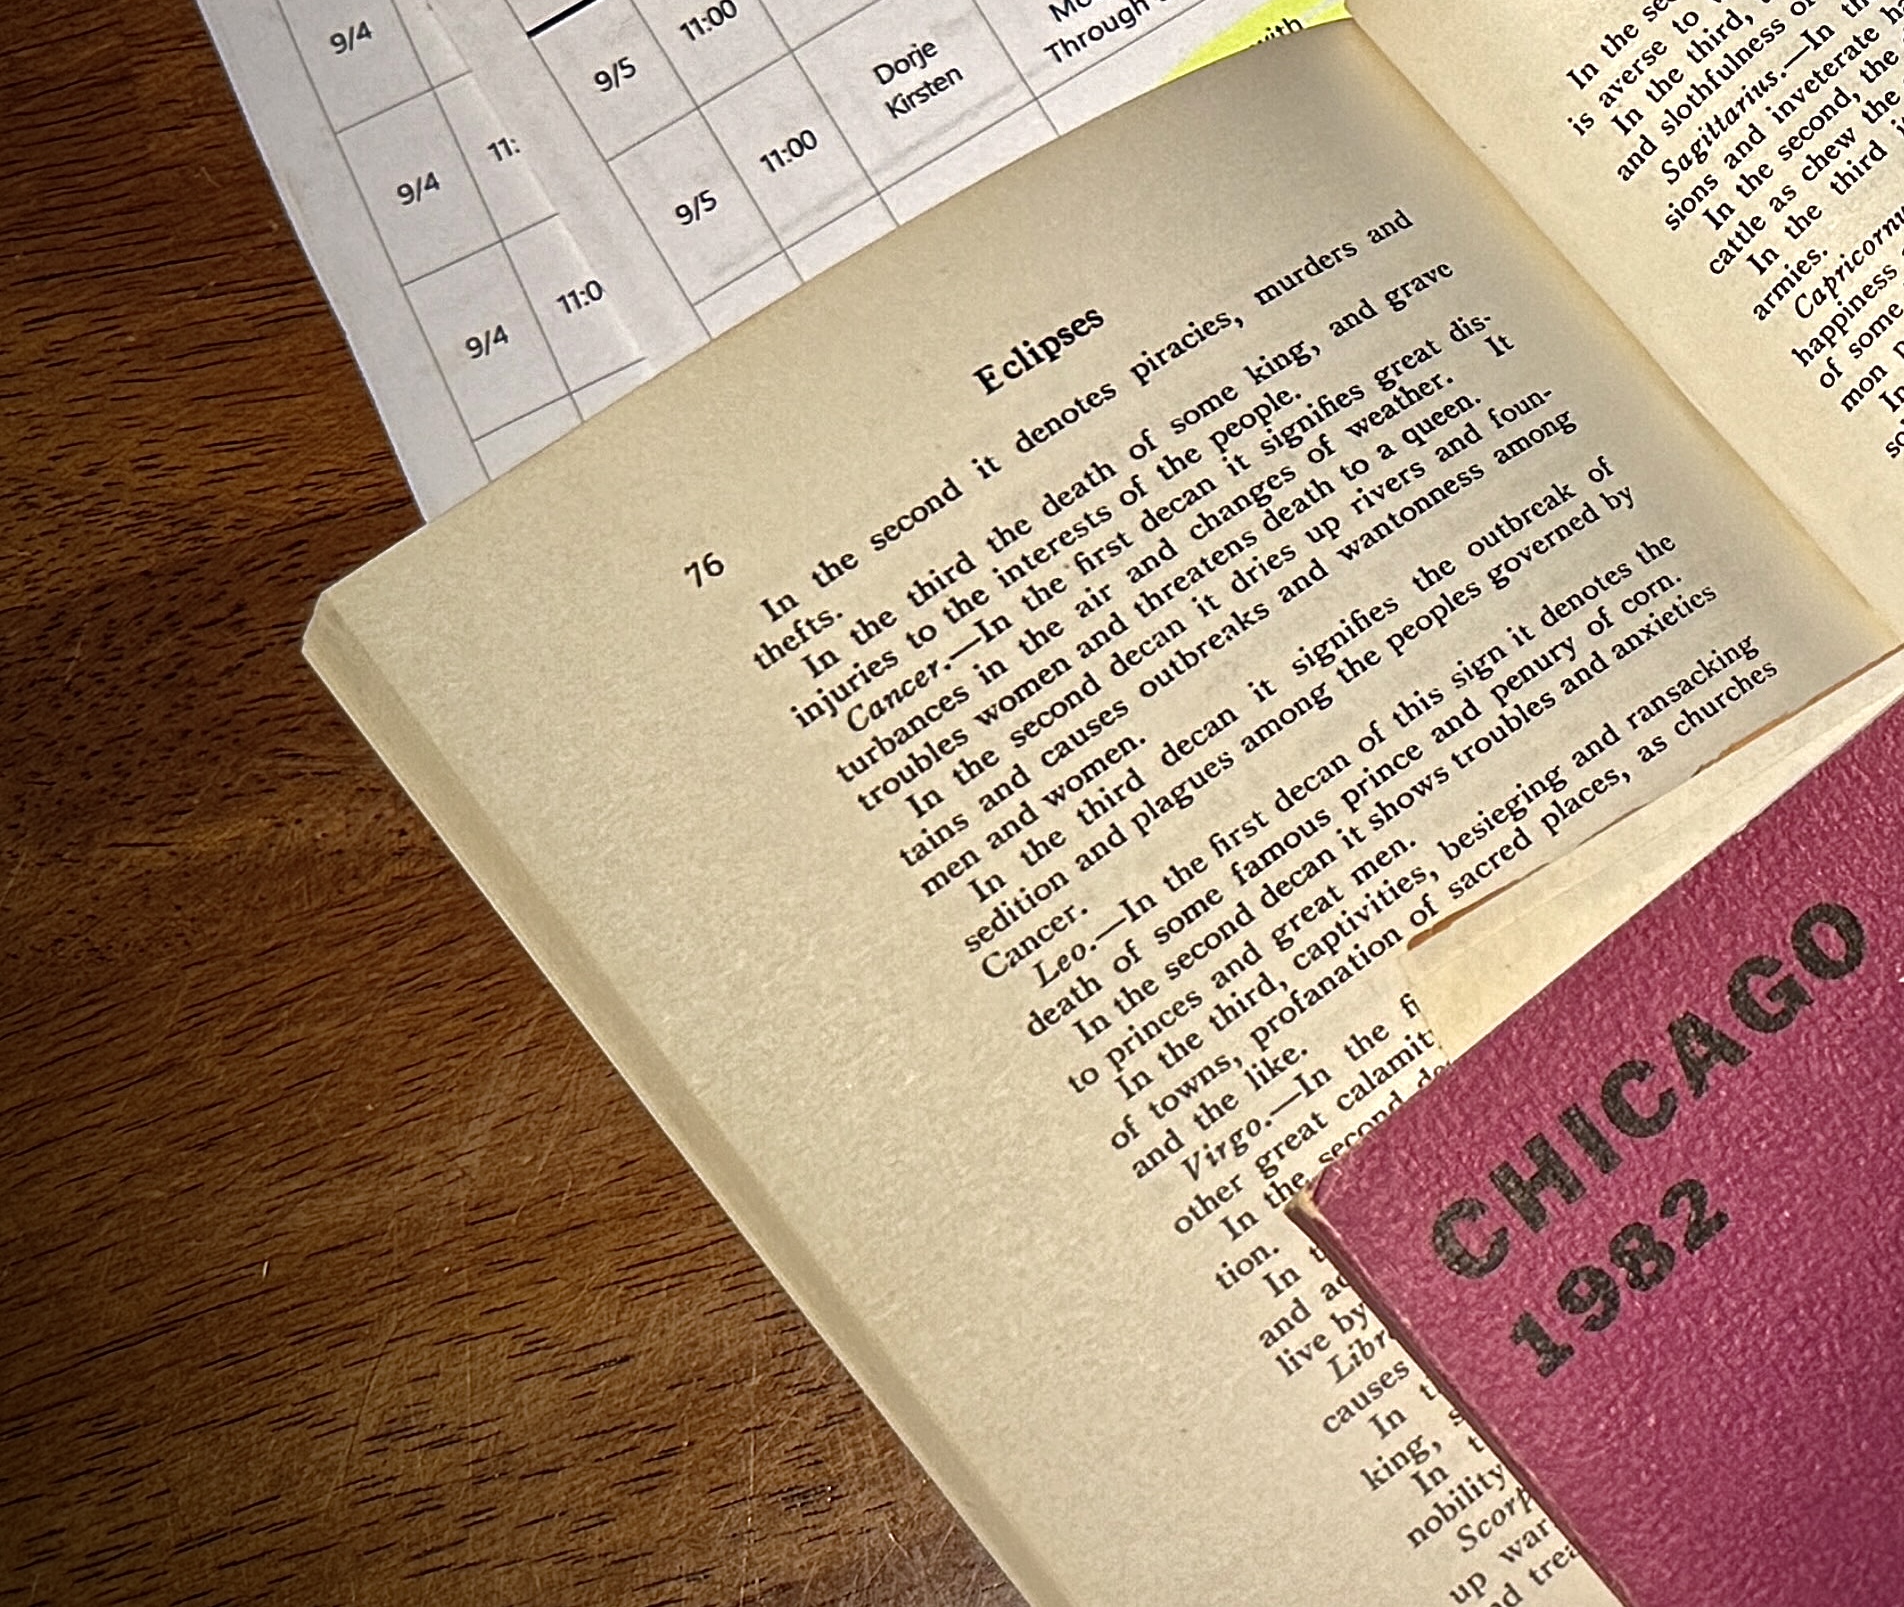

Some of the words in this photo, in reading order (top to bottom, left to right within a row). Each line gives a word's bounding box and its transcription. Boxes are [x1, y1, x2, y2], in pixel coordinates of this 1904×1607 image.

[594, 56, 636, 93] 9/5
[1566, 62, 1600, 90] In
[1600, 24, 1640, 59] the
[972, 309, 1104, 395] Eclipses
[684, 552, 725, 588] 76
[1432, 901, 1868, 1280] CHICAGO
[1215, 1245, 1280, 1290] tion.
[1509, 1179, 1729, 1379] 1982
